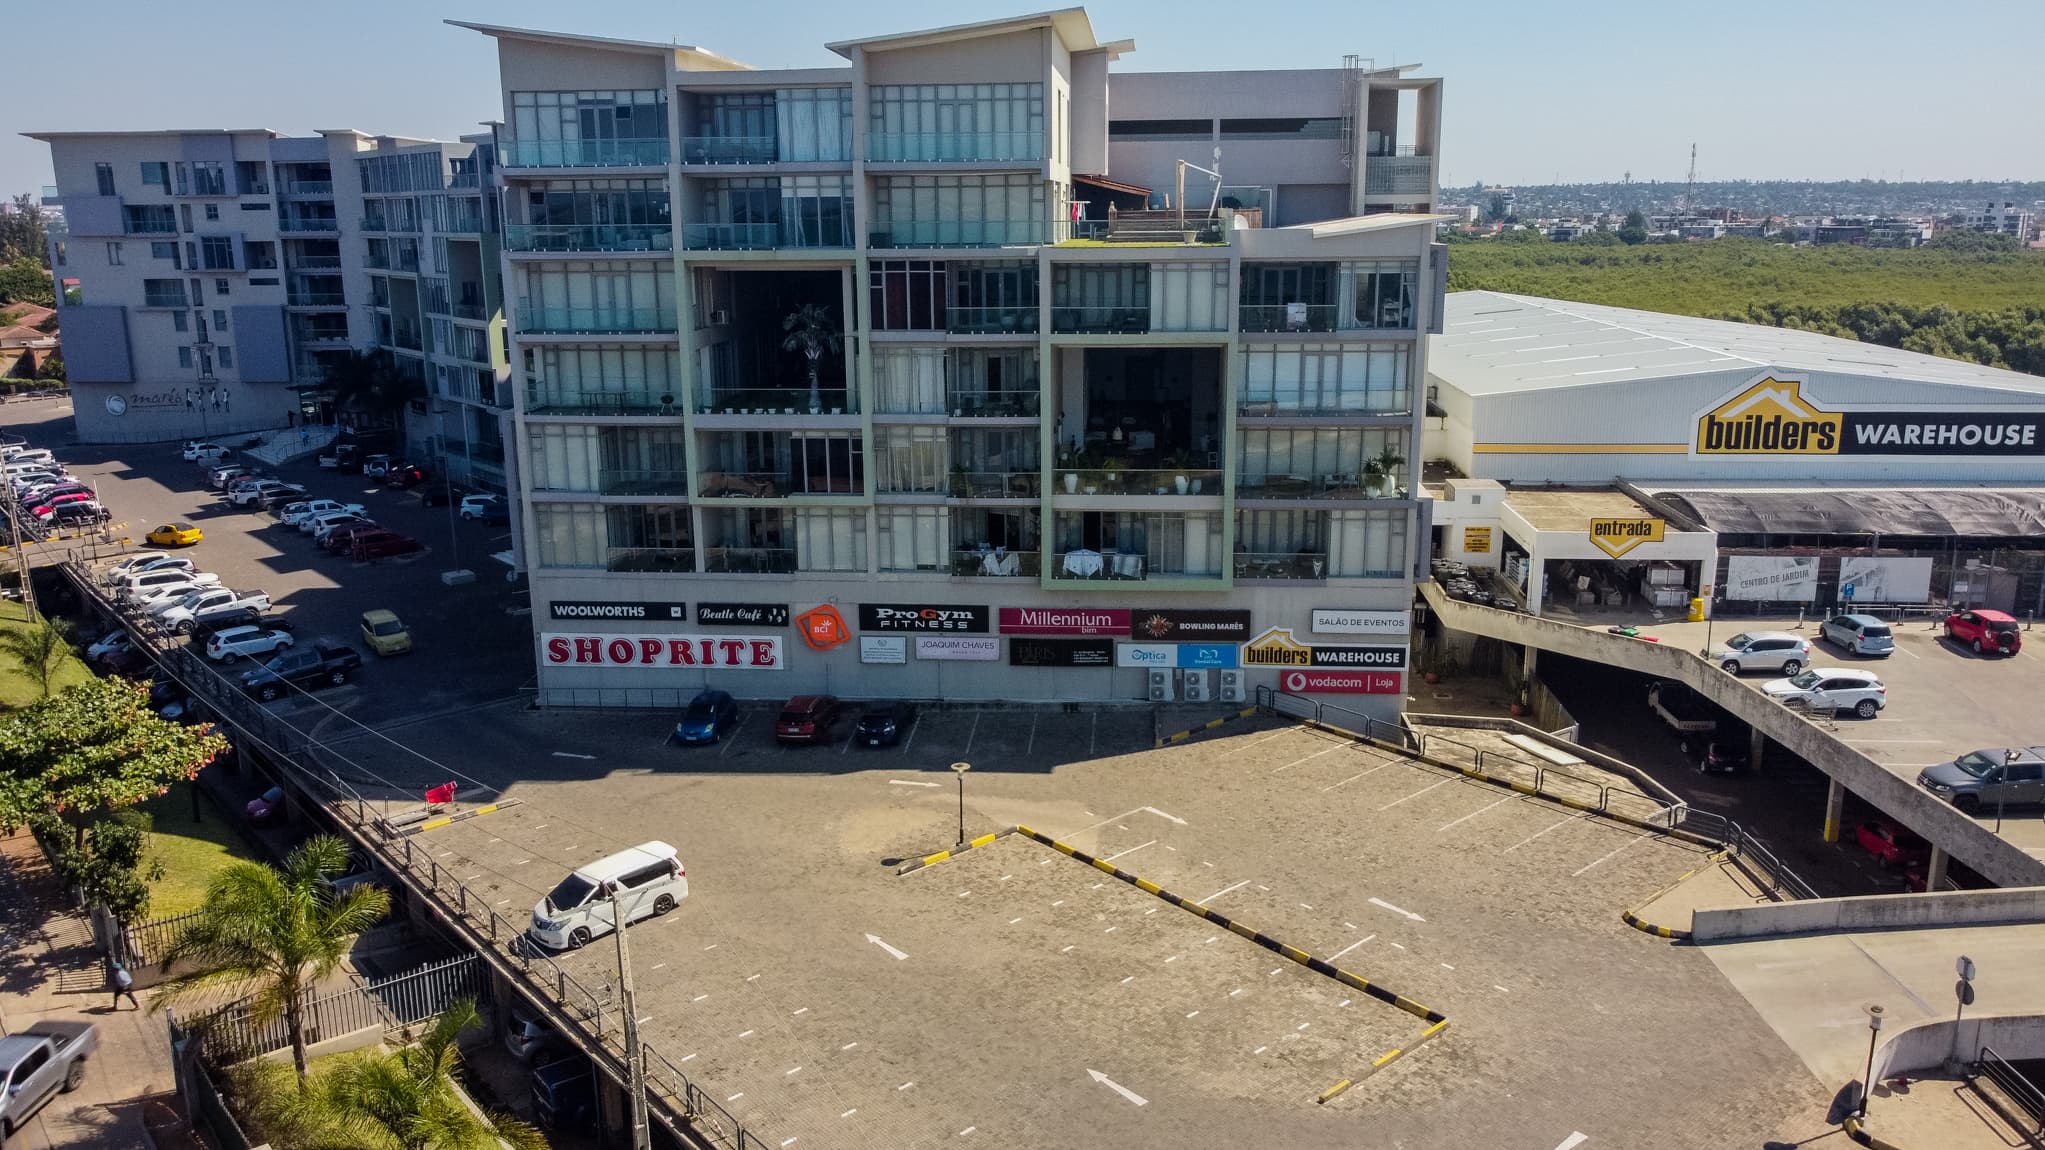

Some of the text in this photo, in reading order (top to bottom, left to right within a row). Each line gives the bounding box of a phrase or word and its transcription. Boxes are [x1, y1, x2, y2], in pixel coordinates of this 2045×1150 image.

[1705, 414, 2037, 450] builders WAREHOUSE
[1594, 520, 1652, 536] entrada
[1740, 569, 1809, 591] CENTRO DE JARDIM
[554, 605, 645, 617] WOOLWORTHS
[737, 609, 762, 622] Café
[876, 608, 974, 620] ProGym
[1020, 608, 1112, 626] Millennium
[880, 620, 968, 629] FITNESS
[1179, 622, 1215, 630] BOWLING
[1318, 616, 1405, 627] SALÃO DE EVENTOS
[921, 641, 995, 650] JOAQUIM CHAVES
[548, 637, 776, 667] SHOPRITE
[1247, 645, 1400, 665] builders WAREHOUSE
[1309, 677, 1394, 689] vodacom Loja
